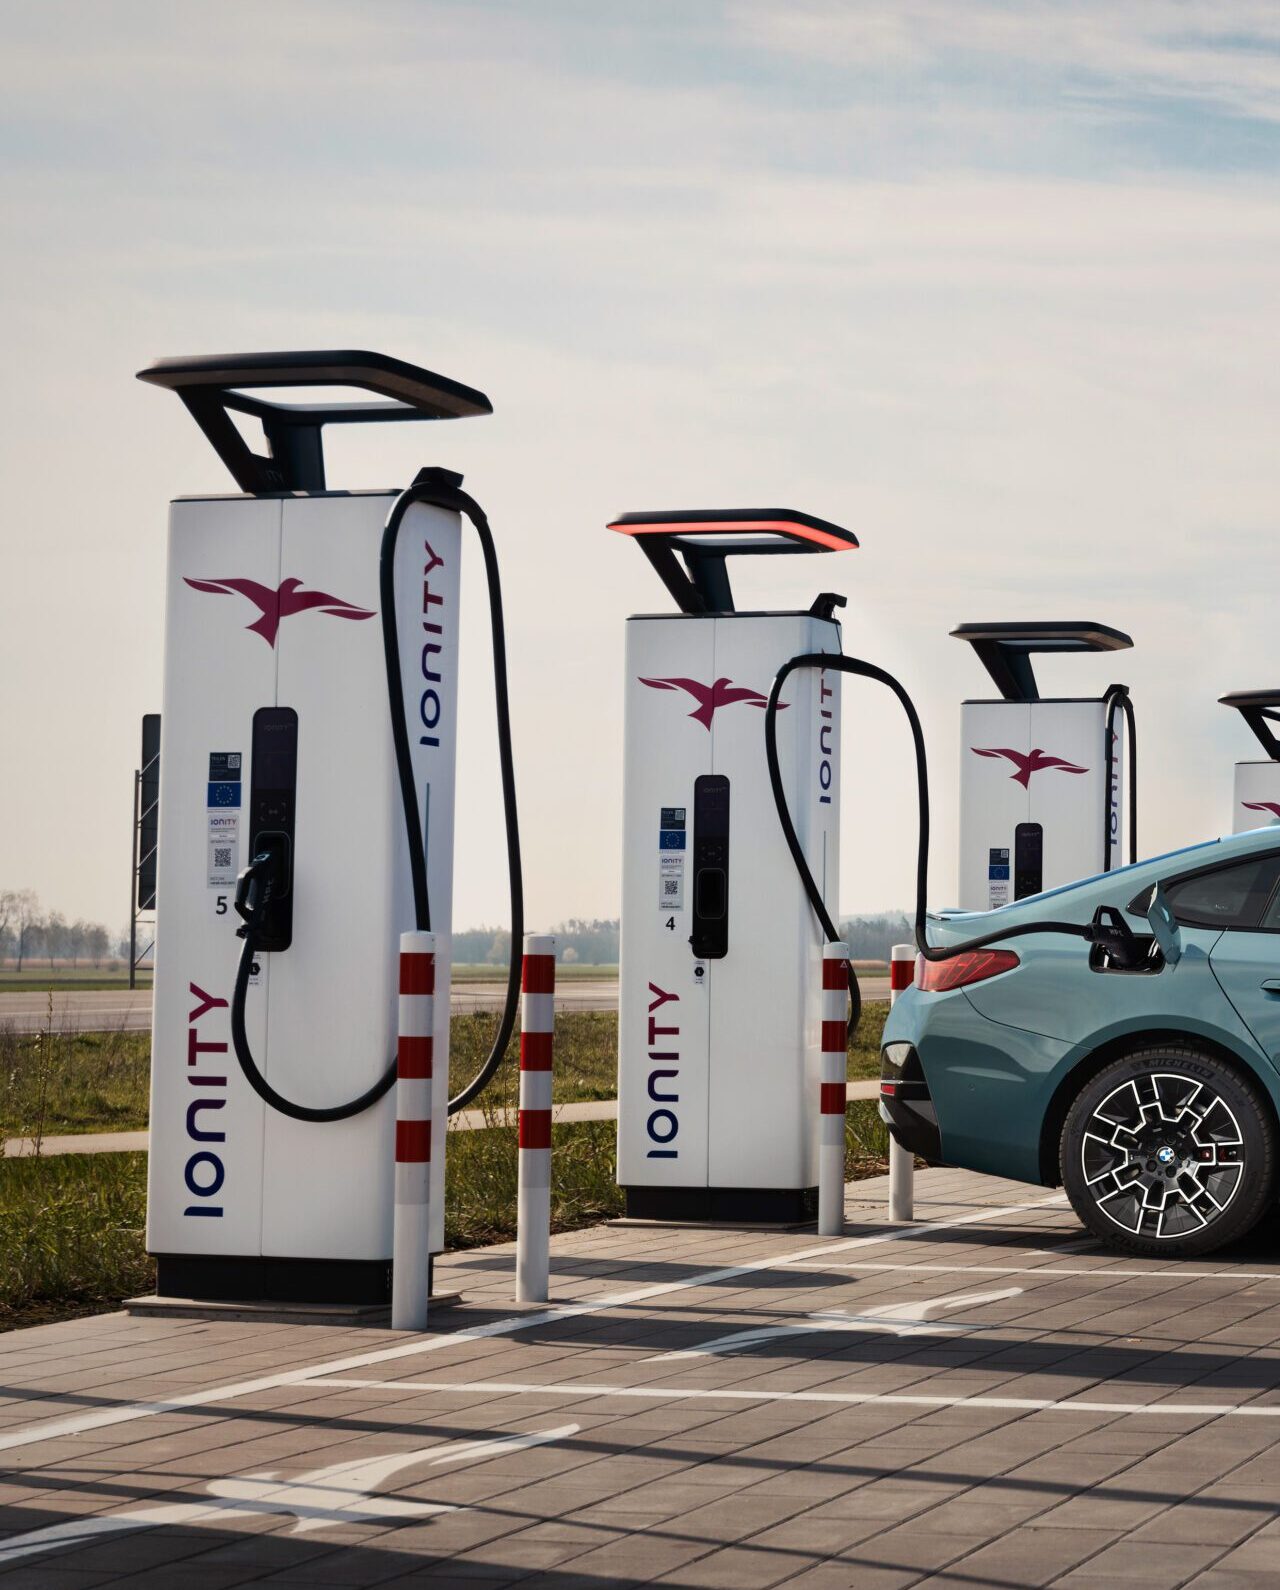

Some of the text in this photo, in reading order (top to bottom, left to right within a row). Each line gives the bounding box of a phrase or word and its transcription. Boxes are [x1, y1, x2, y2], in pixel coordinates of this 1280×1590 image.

[419, 539, 445, 747] IONITY
[210, 818, 237, 826] IONITY
[215, 895, 228, 915] 5
[665, 916, 676, 931] 4
[183, 981, 229, 1218] IONITY
[646, 981, 680, 1159] IONITY
